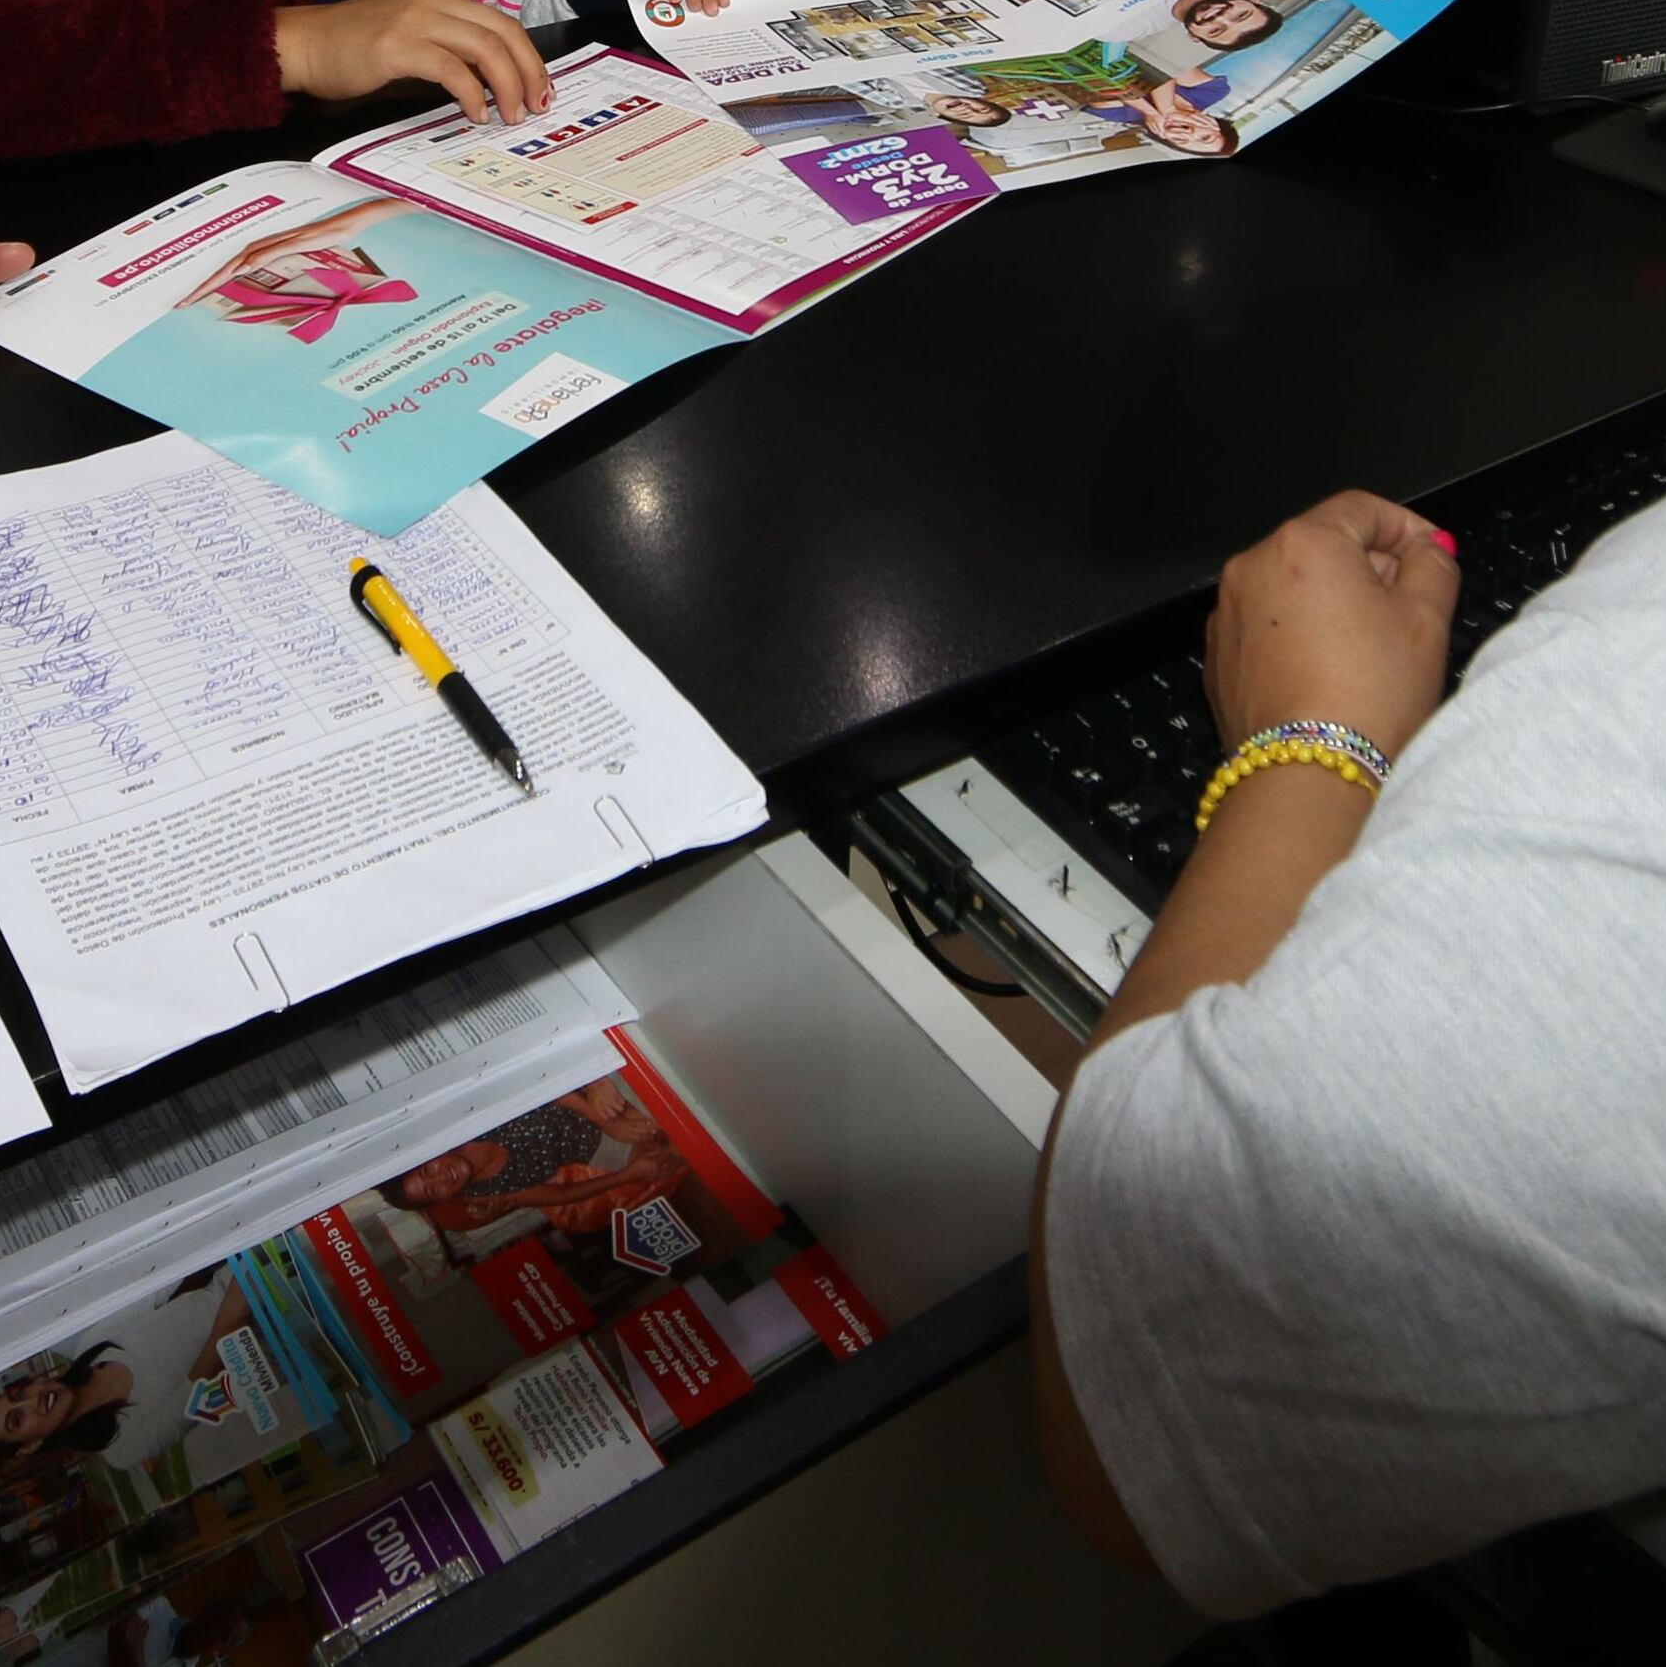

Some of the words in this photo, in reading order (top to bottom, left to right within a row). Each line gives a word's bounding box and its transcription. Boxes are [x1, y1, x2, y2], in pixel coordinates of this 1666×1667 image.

[704, 65, 777, 87] DEPA
[835, 152, 934, 186] DORM.
[851, 151, 904, 170] Desde
[888, 197, 912, 210] de
[913, 181, 970, 202] Depas
[113, 198, 270, 281] nexoinmobiliario.pe
[108, 272, 159, 301] EXCLUSIVO
[431, 300, 493, 334] Explanada
[477, 312, 496, 325] 12
[493, 297, 608, 354] ¡Regálate
[496, 303, 518, 319] Del
[426, 337, 446, 351] de
[353, 348, 427, 393] setiembre
[463, 351, 496, 368] la
[412, 366, 469, 396] Casa
[335, 396, 421, 454] Propia!
[229, 728, 285, 755] NOMBRES
[116, 778, 155, 797] FIRMA
[10, 808, 50, 825] FECHA
[434, 824, 456, 839] DEL
[349, 834, 431, 872] TRATAMIENTO
[289, 874, 331, 894] DATOS
[207, 890, 290, 928] PERSONALES
[641, 1205, 688, 1256] propio
[321, 1223, 367, 1281] propia
[353, 1276, 374, 1298] tu
[813, 1276, 835, 1301] ¡Tu
[833, 1297, 874, 1347] familia
[363, 1292, 426, 1379] ¡Construye
[670, 1308, 720, 1369] Modalidad
[638, 1310, 675, 1361] Vivienda
[670, 1358, 701, 1397] Nueva
[643, 1348, 669, 1376] AVN
[695, 1367, 711, 1385] de
[466, 1409, 490, 1435] S/
[606, 1414, 632, 1447] otorga
[365, 1515, 426, 1587] CONS
